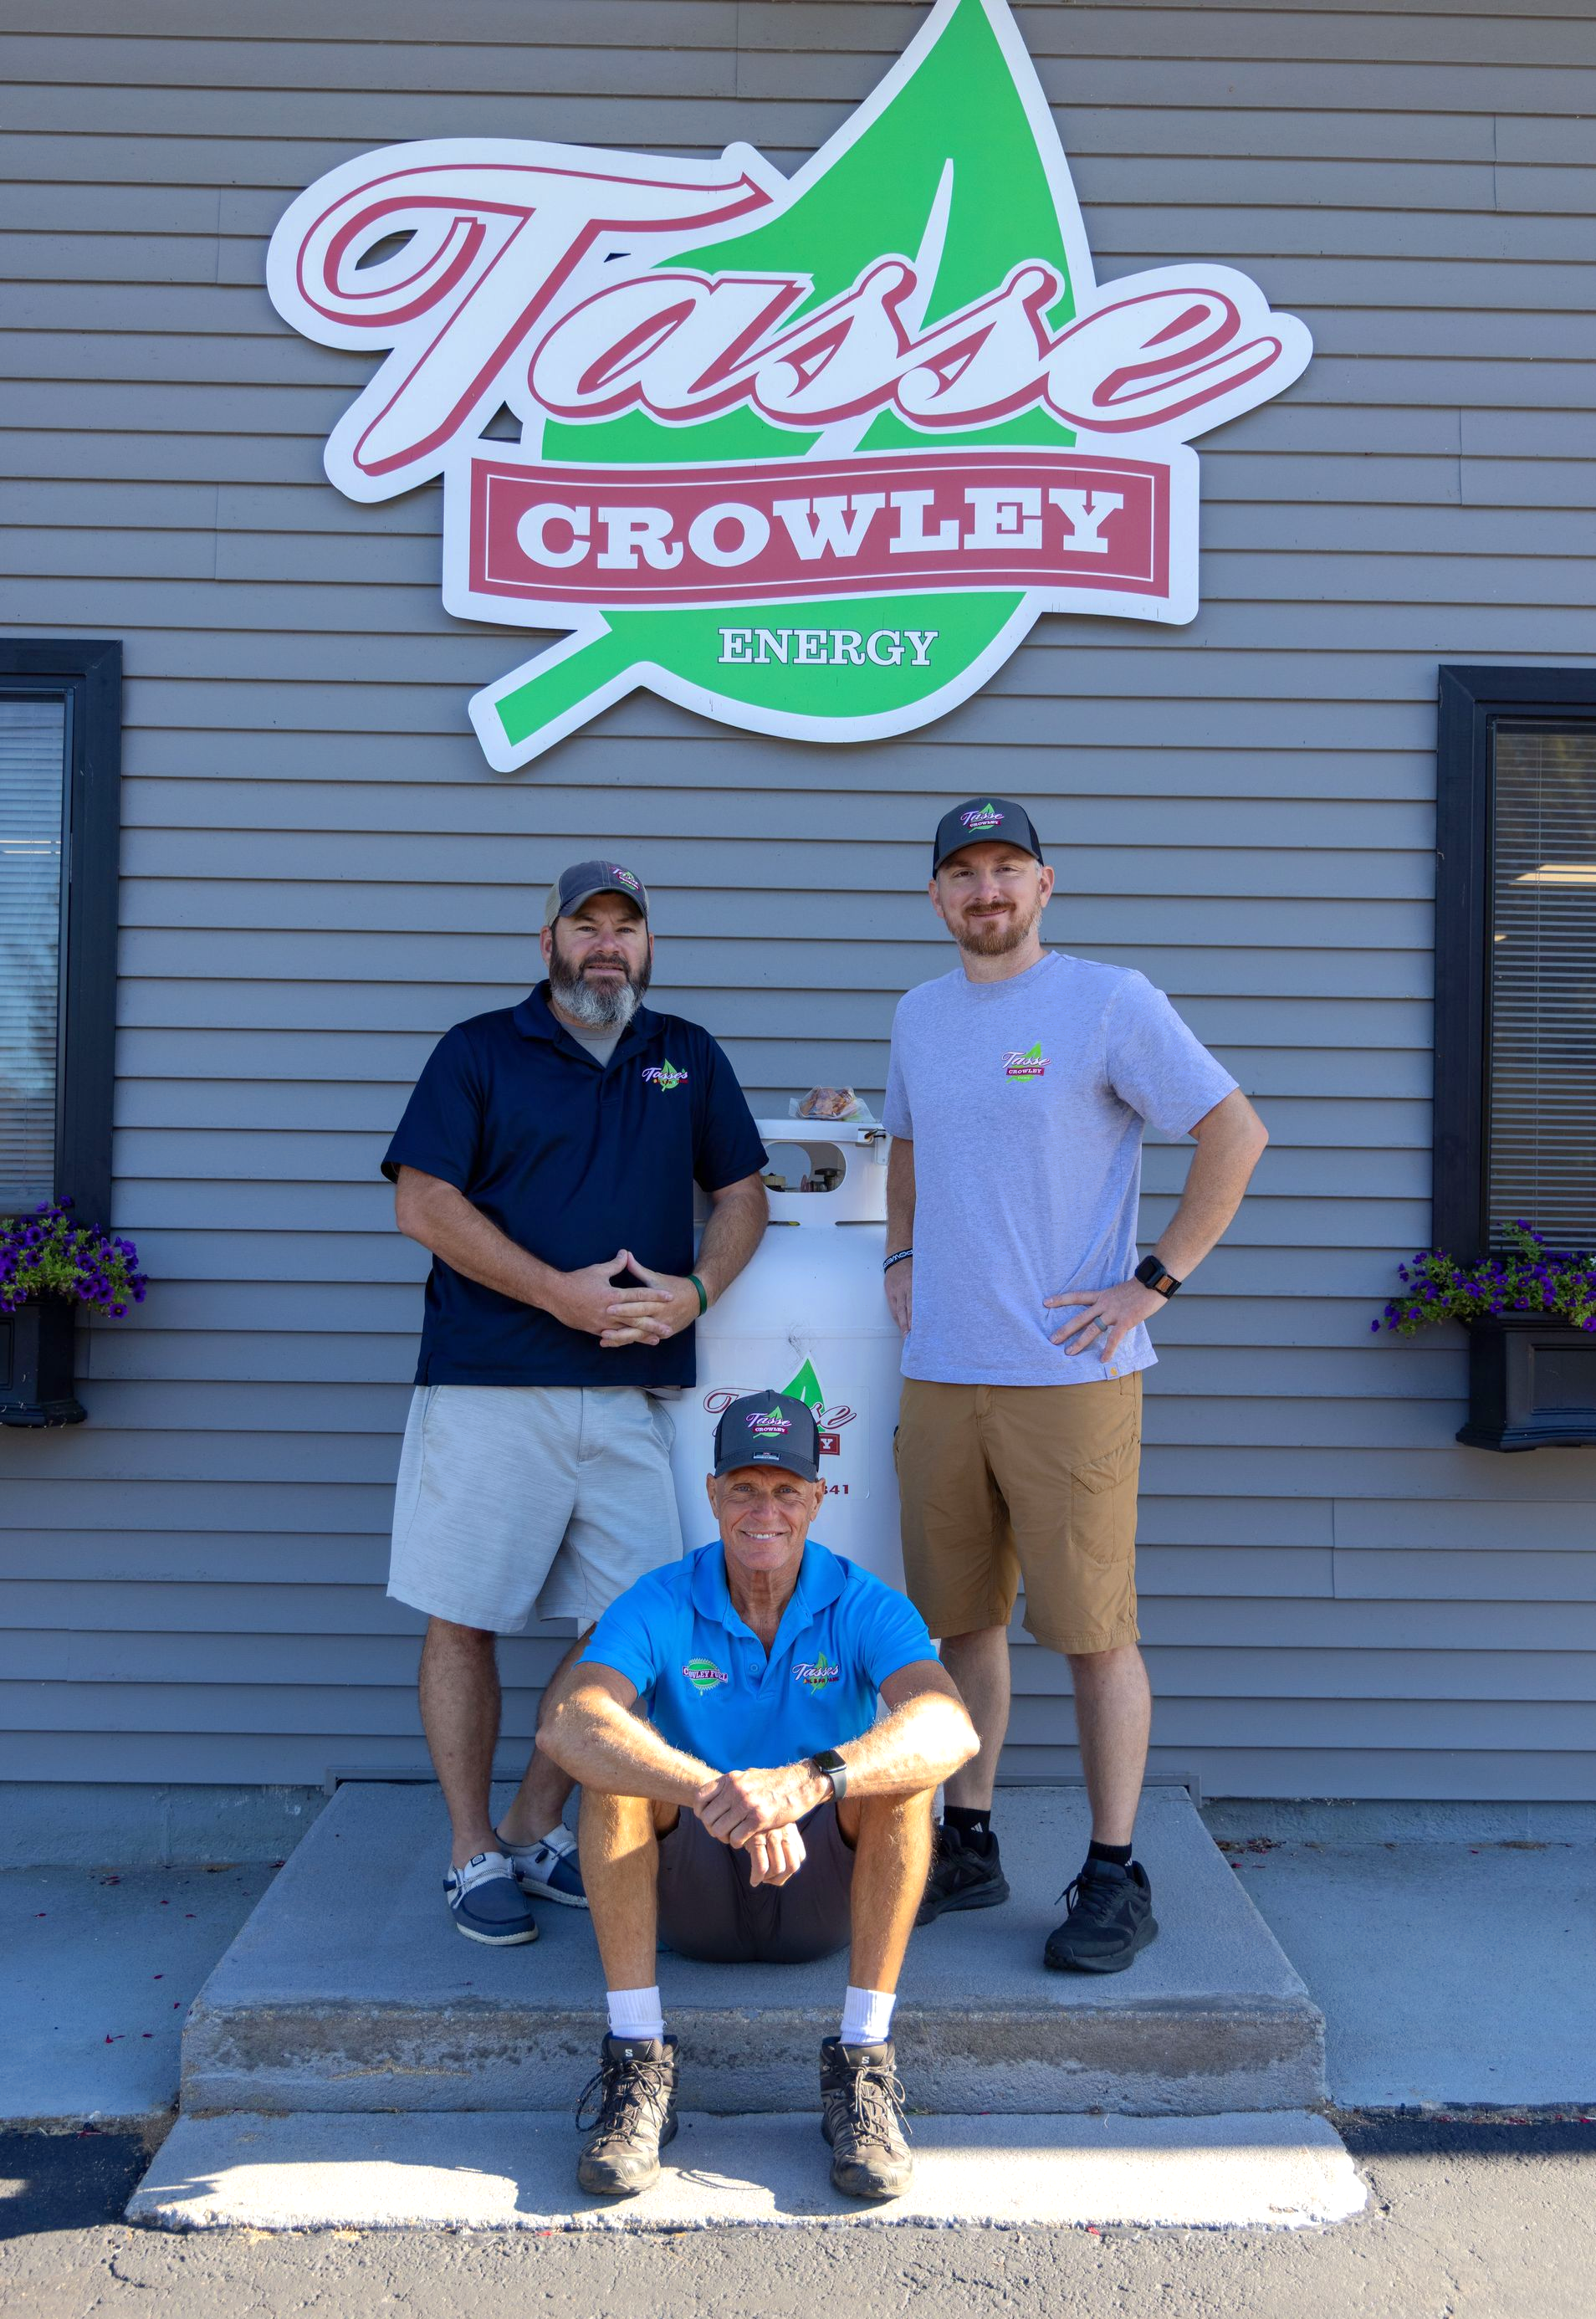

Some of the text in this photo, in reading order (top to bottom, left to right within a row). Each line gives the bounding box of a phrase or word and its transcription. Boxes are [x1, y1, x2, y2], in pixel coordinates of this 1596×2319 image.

[298, 164, 1281, 476] Tasse
[517, 488, 1123, 570] CROWLEY
[718, 628, 939, 666] ENERGY
[960, 811, 1005, 826] Tasse
[1001, 1052, 1051, 1068] Tasse
[746, 1413, 792, 1427] Tasse
